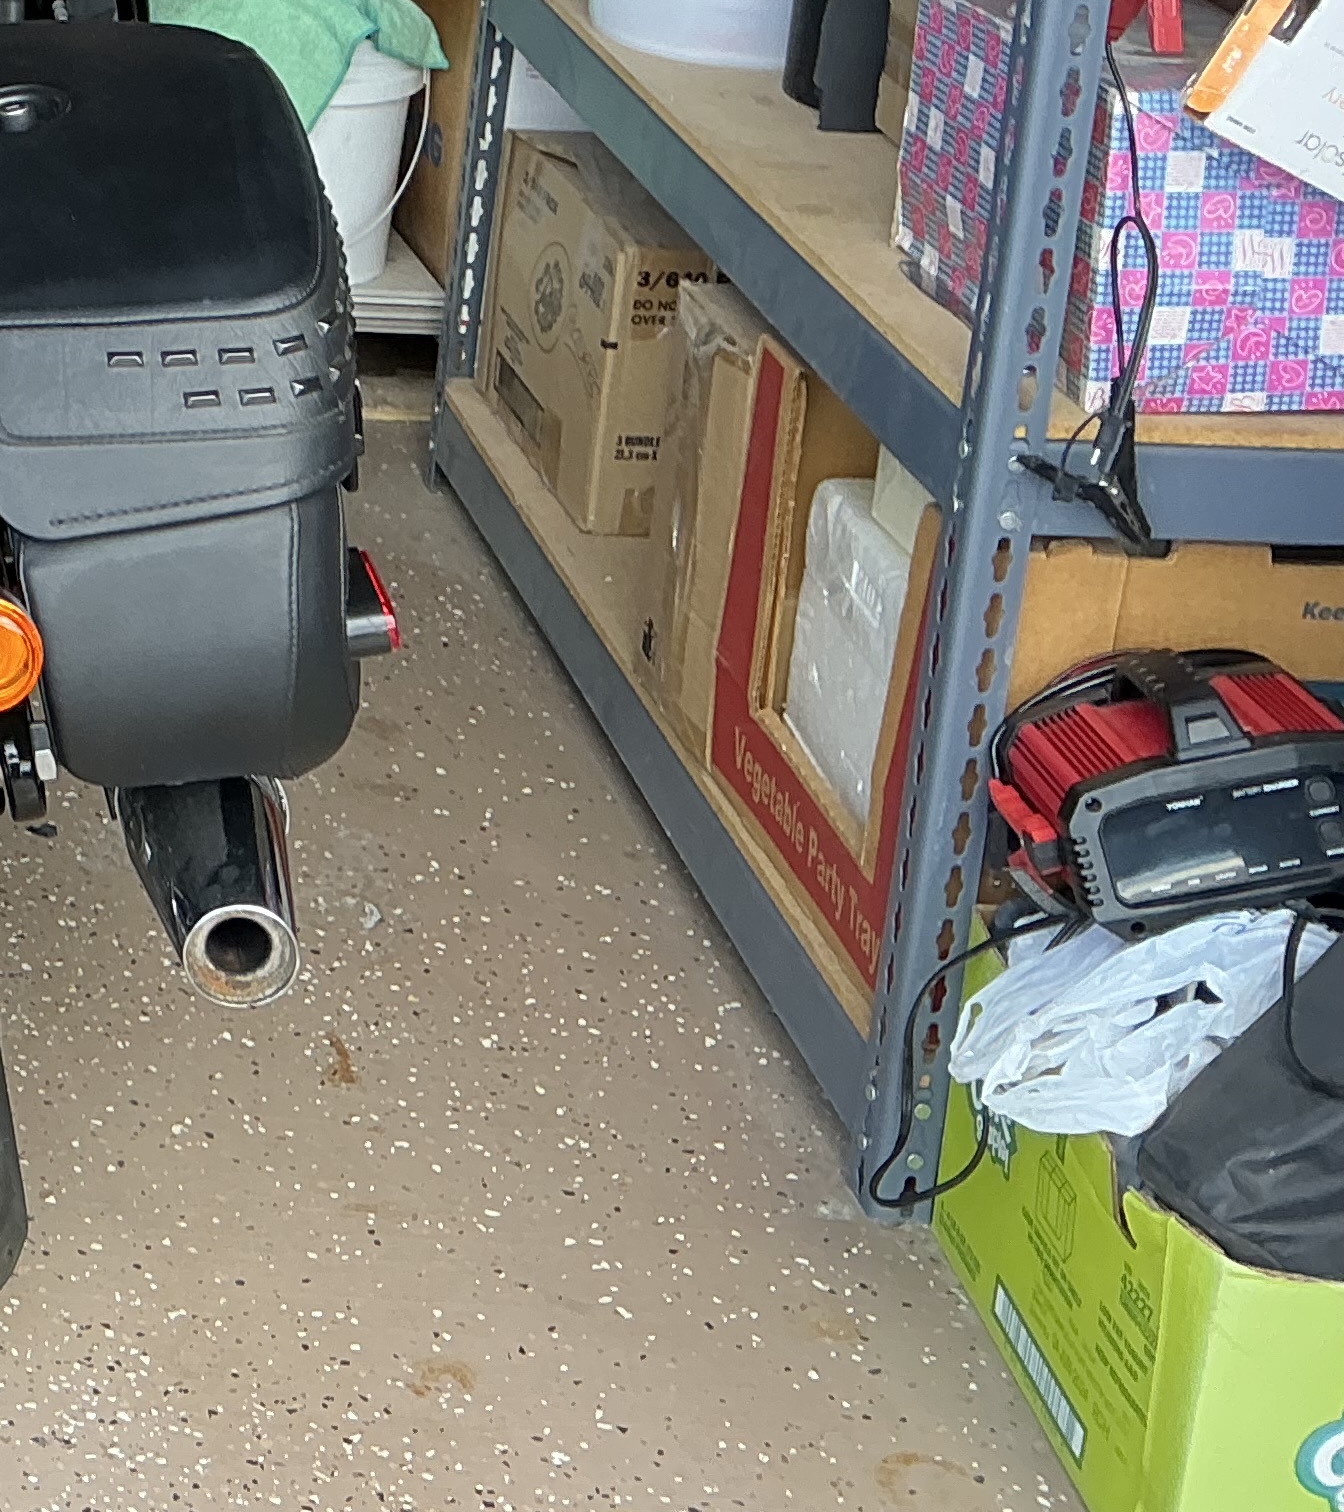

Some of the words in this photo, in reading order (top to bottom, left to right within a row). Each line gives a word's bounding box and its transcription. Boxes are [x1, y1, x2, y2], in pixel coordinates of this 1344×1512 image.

[632, 299, 653, 311] DO
[657, 300, 678, 311] NO
[631, 314, 666, 326] OVER
[733, 727, 804, 847] Vegetable
[805, 831, 848, 921] Party
[846, 893, 881, 978] Tray
